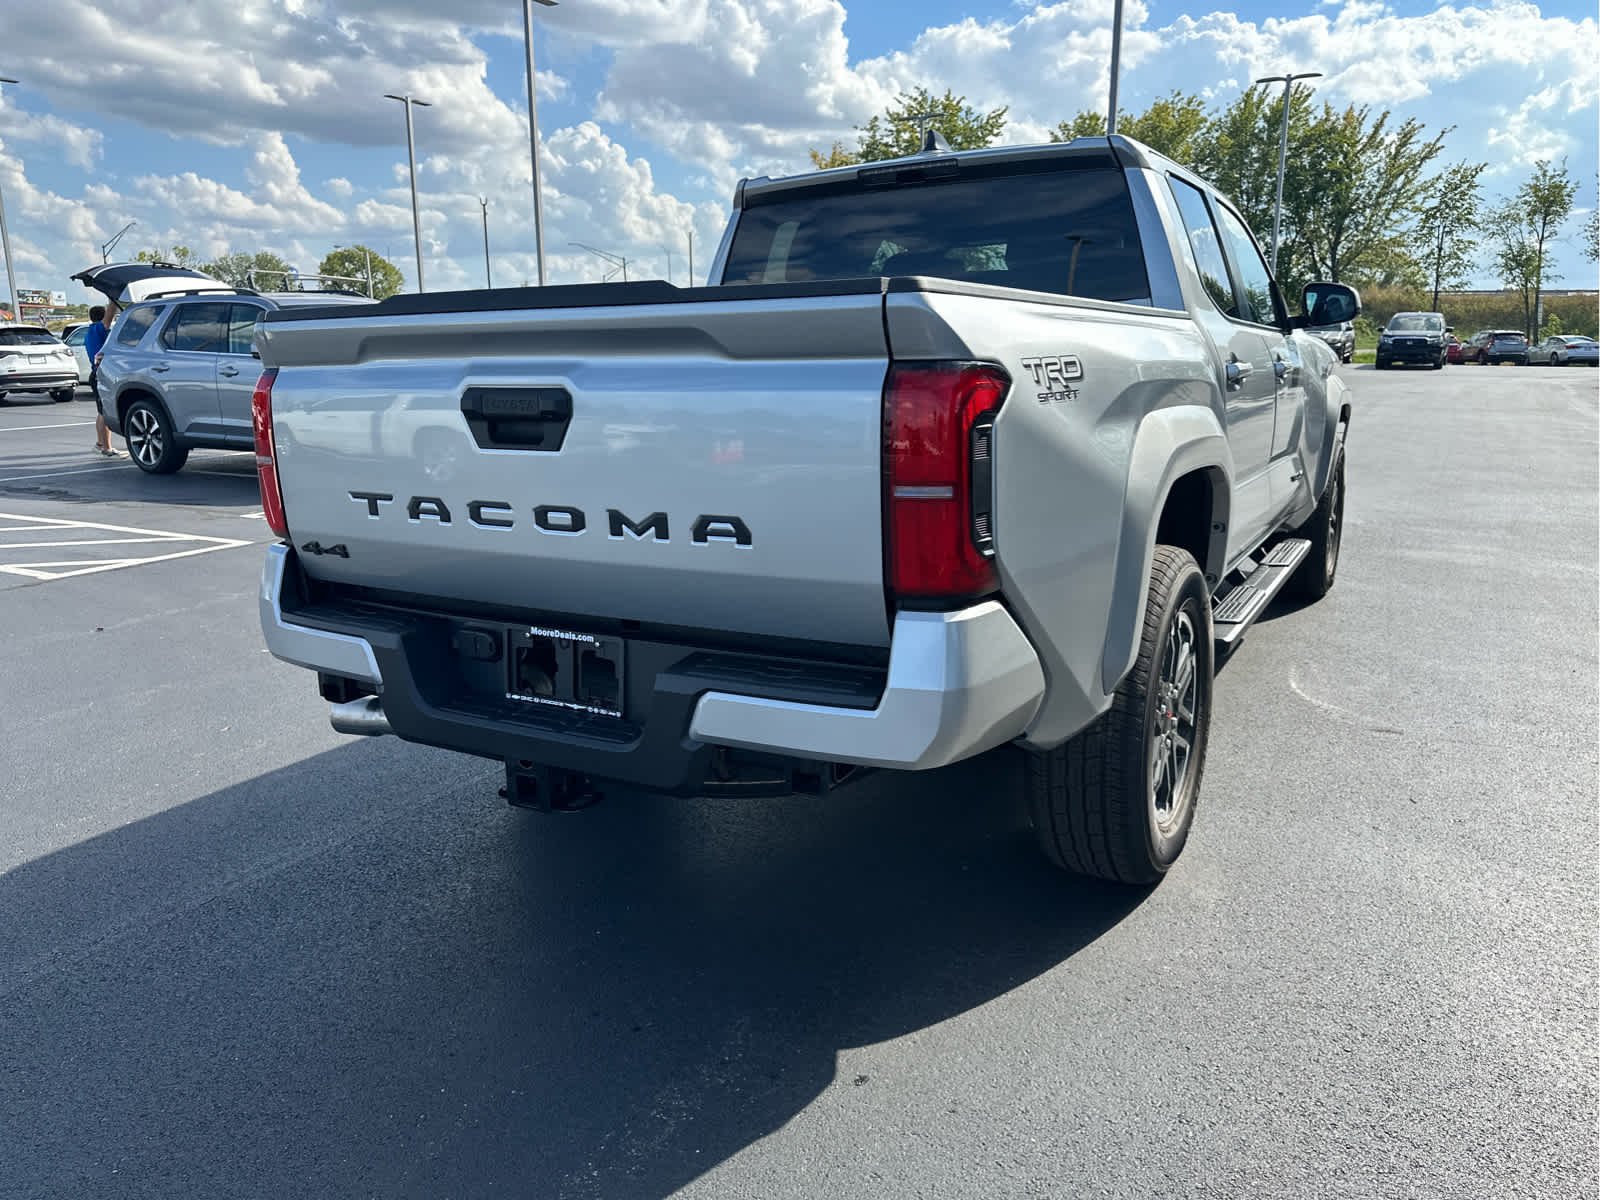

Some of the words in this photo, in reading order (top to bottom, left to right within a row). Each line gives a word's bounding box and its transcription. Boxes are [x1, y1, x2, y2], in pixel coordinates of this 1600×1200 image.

[1020, 354, 1084, 390] TRD
[1037, 389, 1080, 402] SPORT
[348, 490, 754, 549] TACOMA
[530, 626, 594, 642] MooreDeals.com
